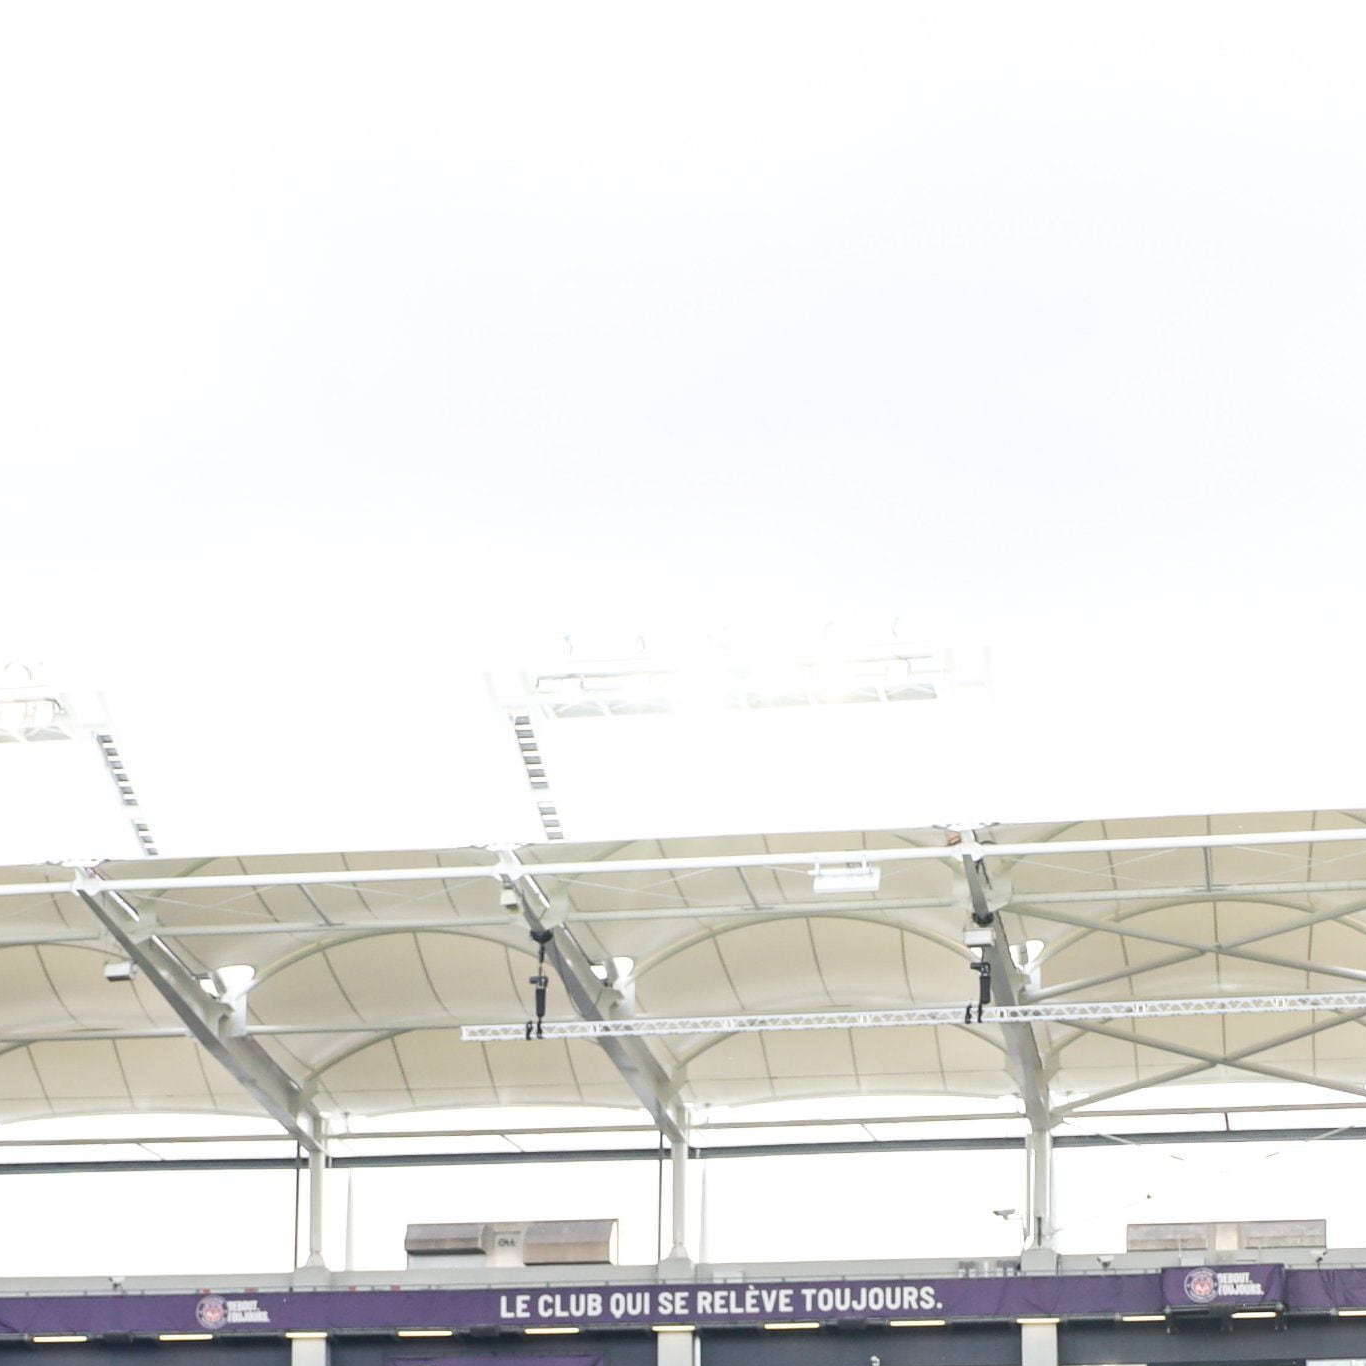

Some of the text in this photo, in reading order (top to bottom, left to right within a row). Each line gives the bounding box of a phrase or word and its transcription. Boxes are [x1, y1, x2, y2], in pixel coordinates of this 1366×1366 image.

[500, 1285, 943, 1319] LE CLUB QUI SE RELÈVE TOUJOURS.
